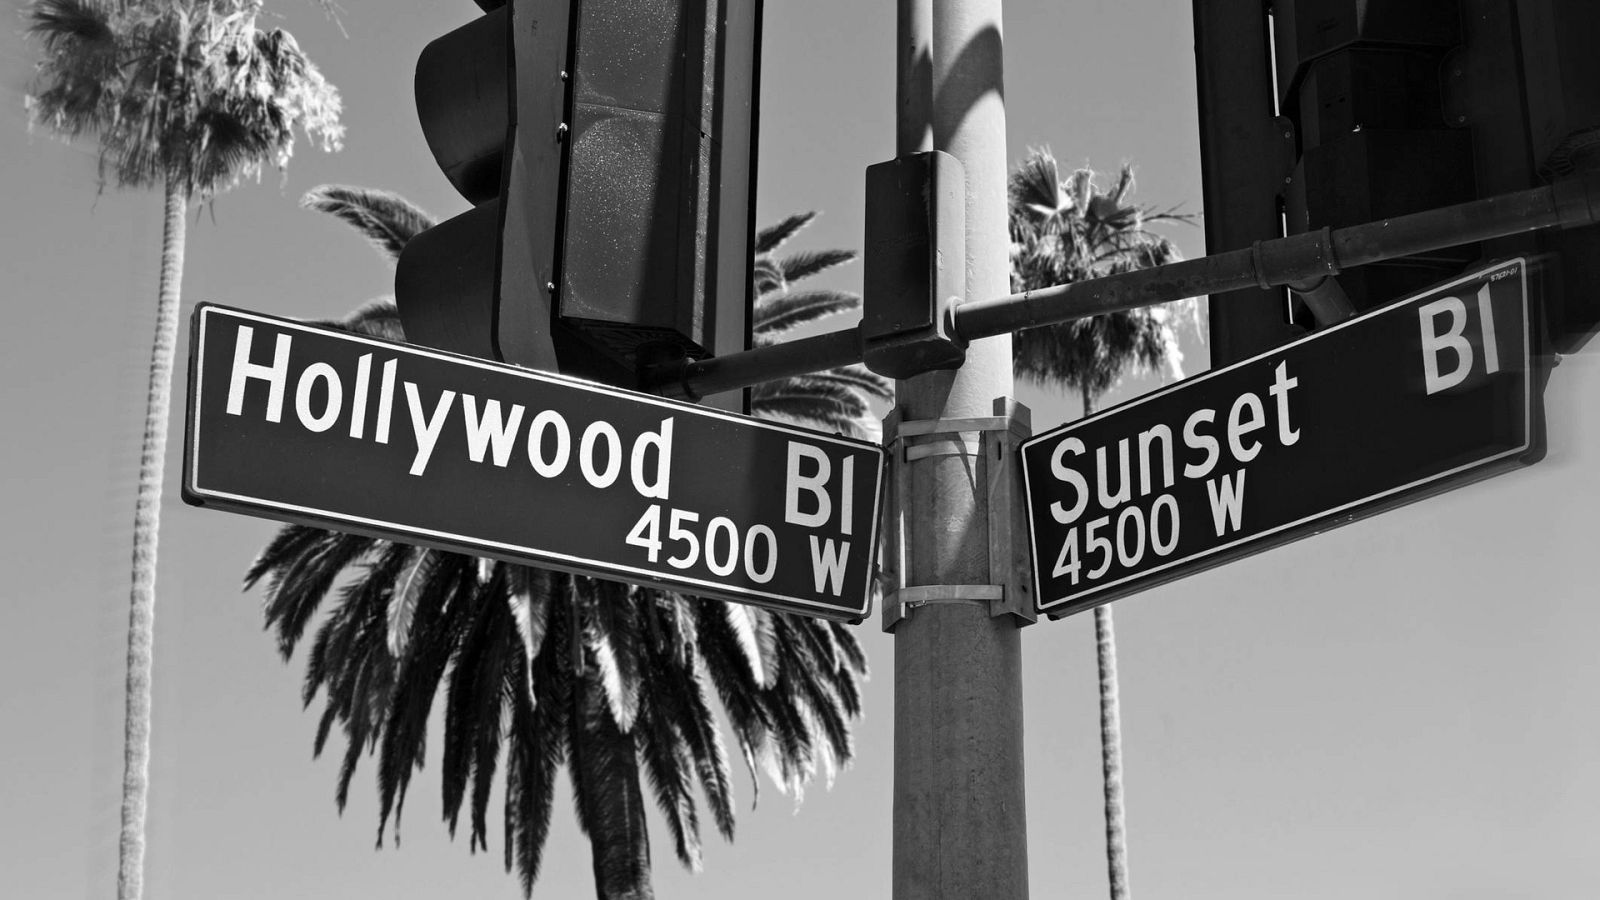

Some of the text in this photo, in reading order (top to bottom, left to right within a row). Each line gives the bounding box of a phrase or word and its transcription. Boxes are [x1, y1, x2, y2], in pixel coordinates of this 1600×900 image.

[226, 325, 854, 536] Hollywood Bl
[1051, 282, 1499, 525] Sunset Bl
[626, 504, 850, 597] 4500 W
[1053, 469, 1246, 585] 4500 W
